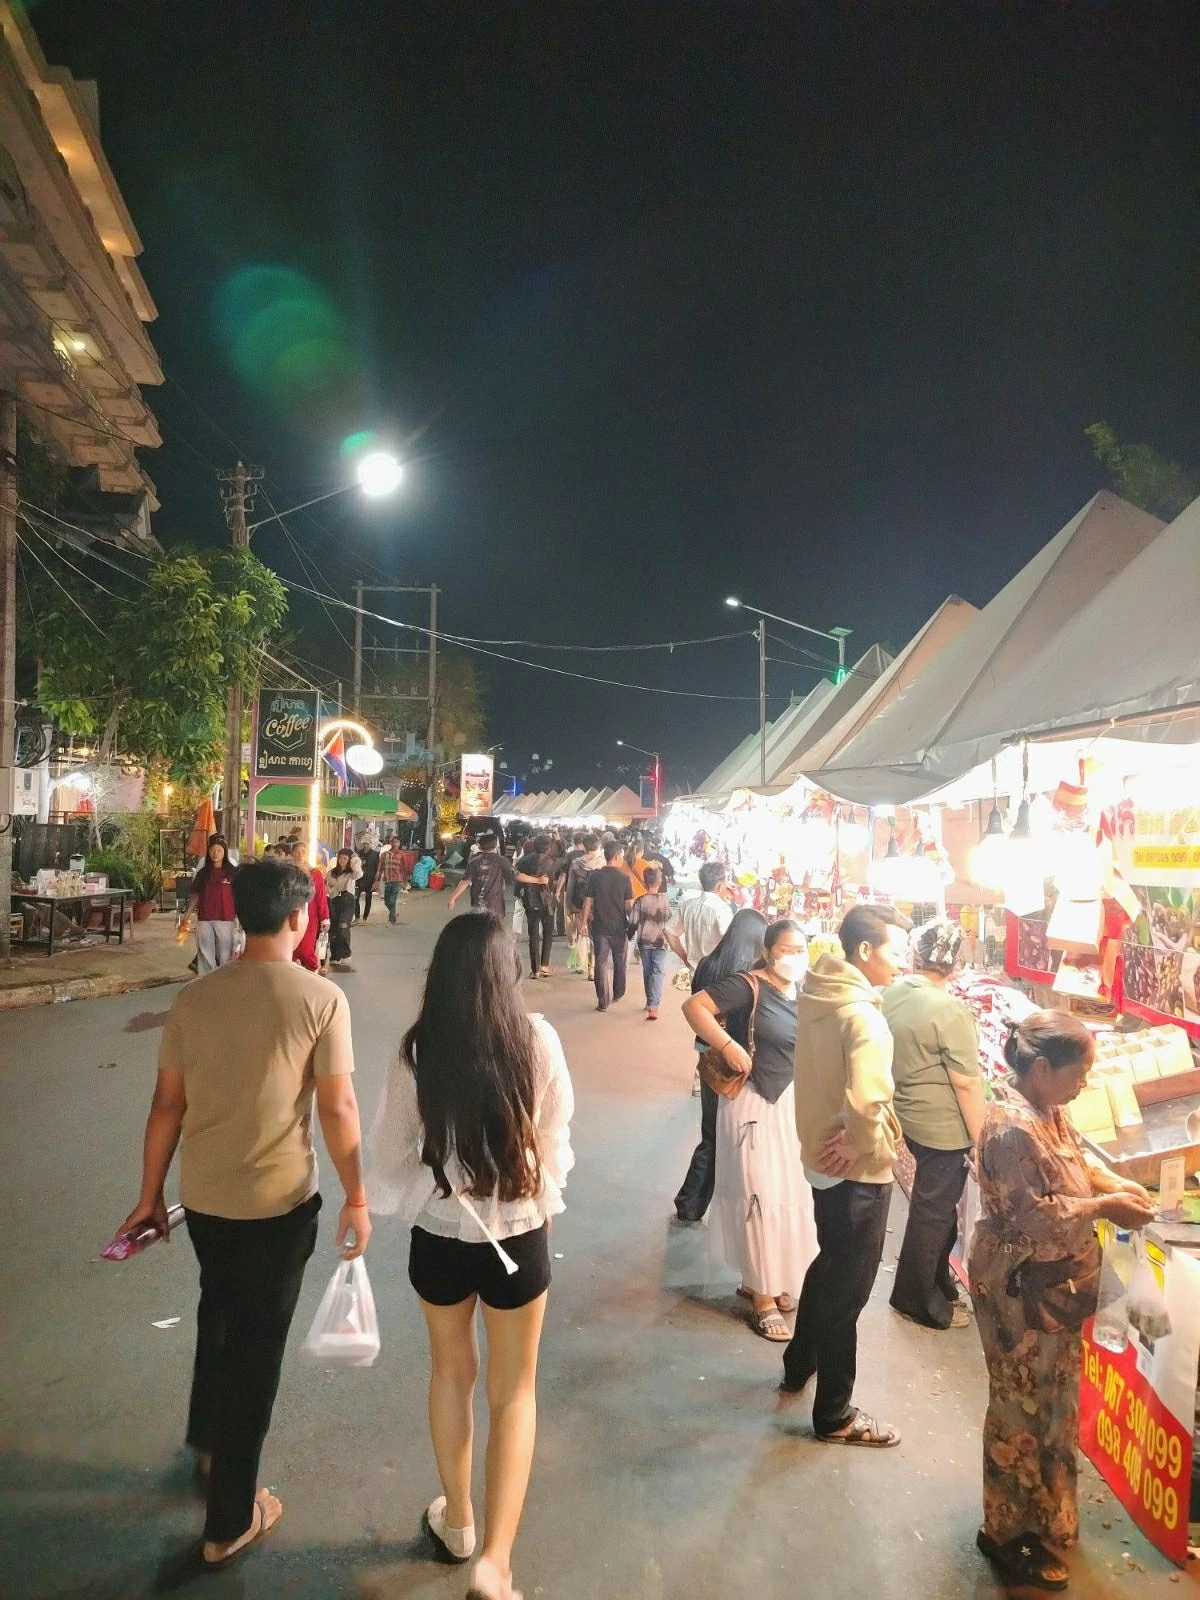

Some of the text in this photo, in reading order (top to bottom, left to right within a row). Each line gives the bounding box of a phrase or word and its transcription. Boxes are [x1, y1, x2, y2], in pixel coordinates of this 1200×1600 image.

[266, 713, 310, 738] Coffee
[1082, 1339, 1103, 1392] Tel:
[1147, 1418, 1182, 1478] 099
[1097, 1409, 1121, 1464] 098
[1143, 1468, 1178, 1529] 099
